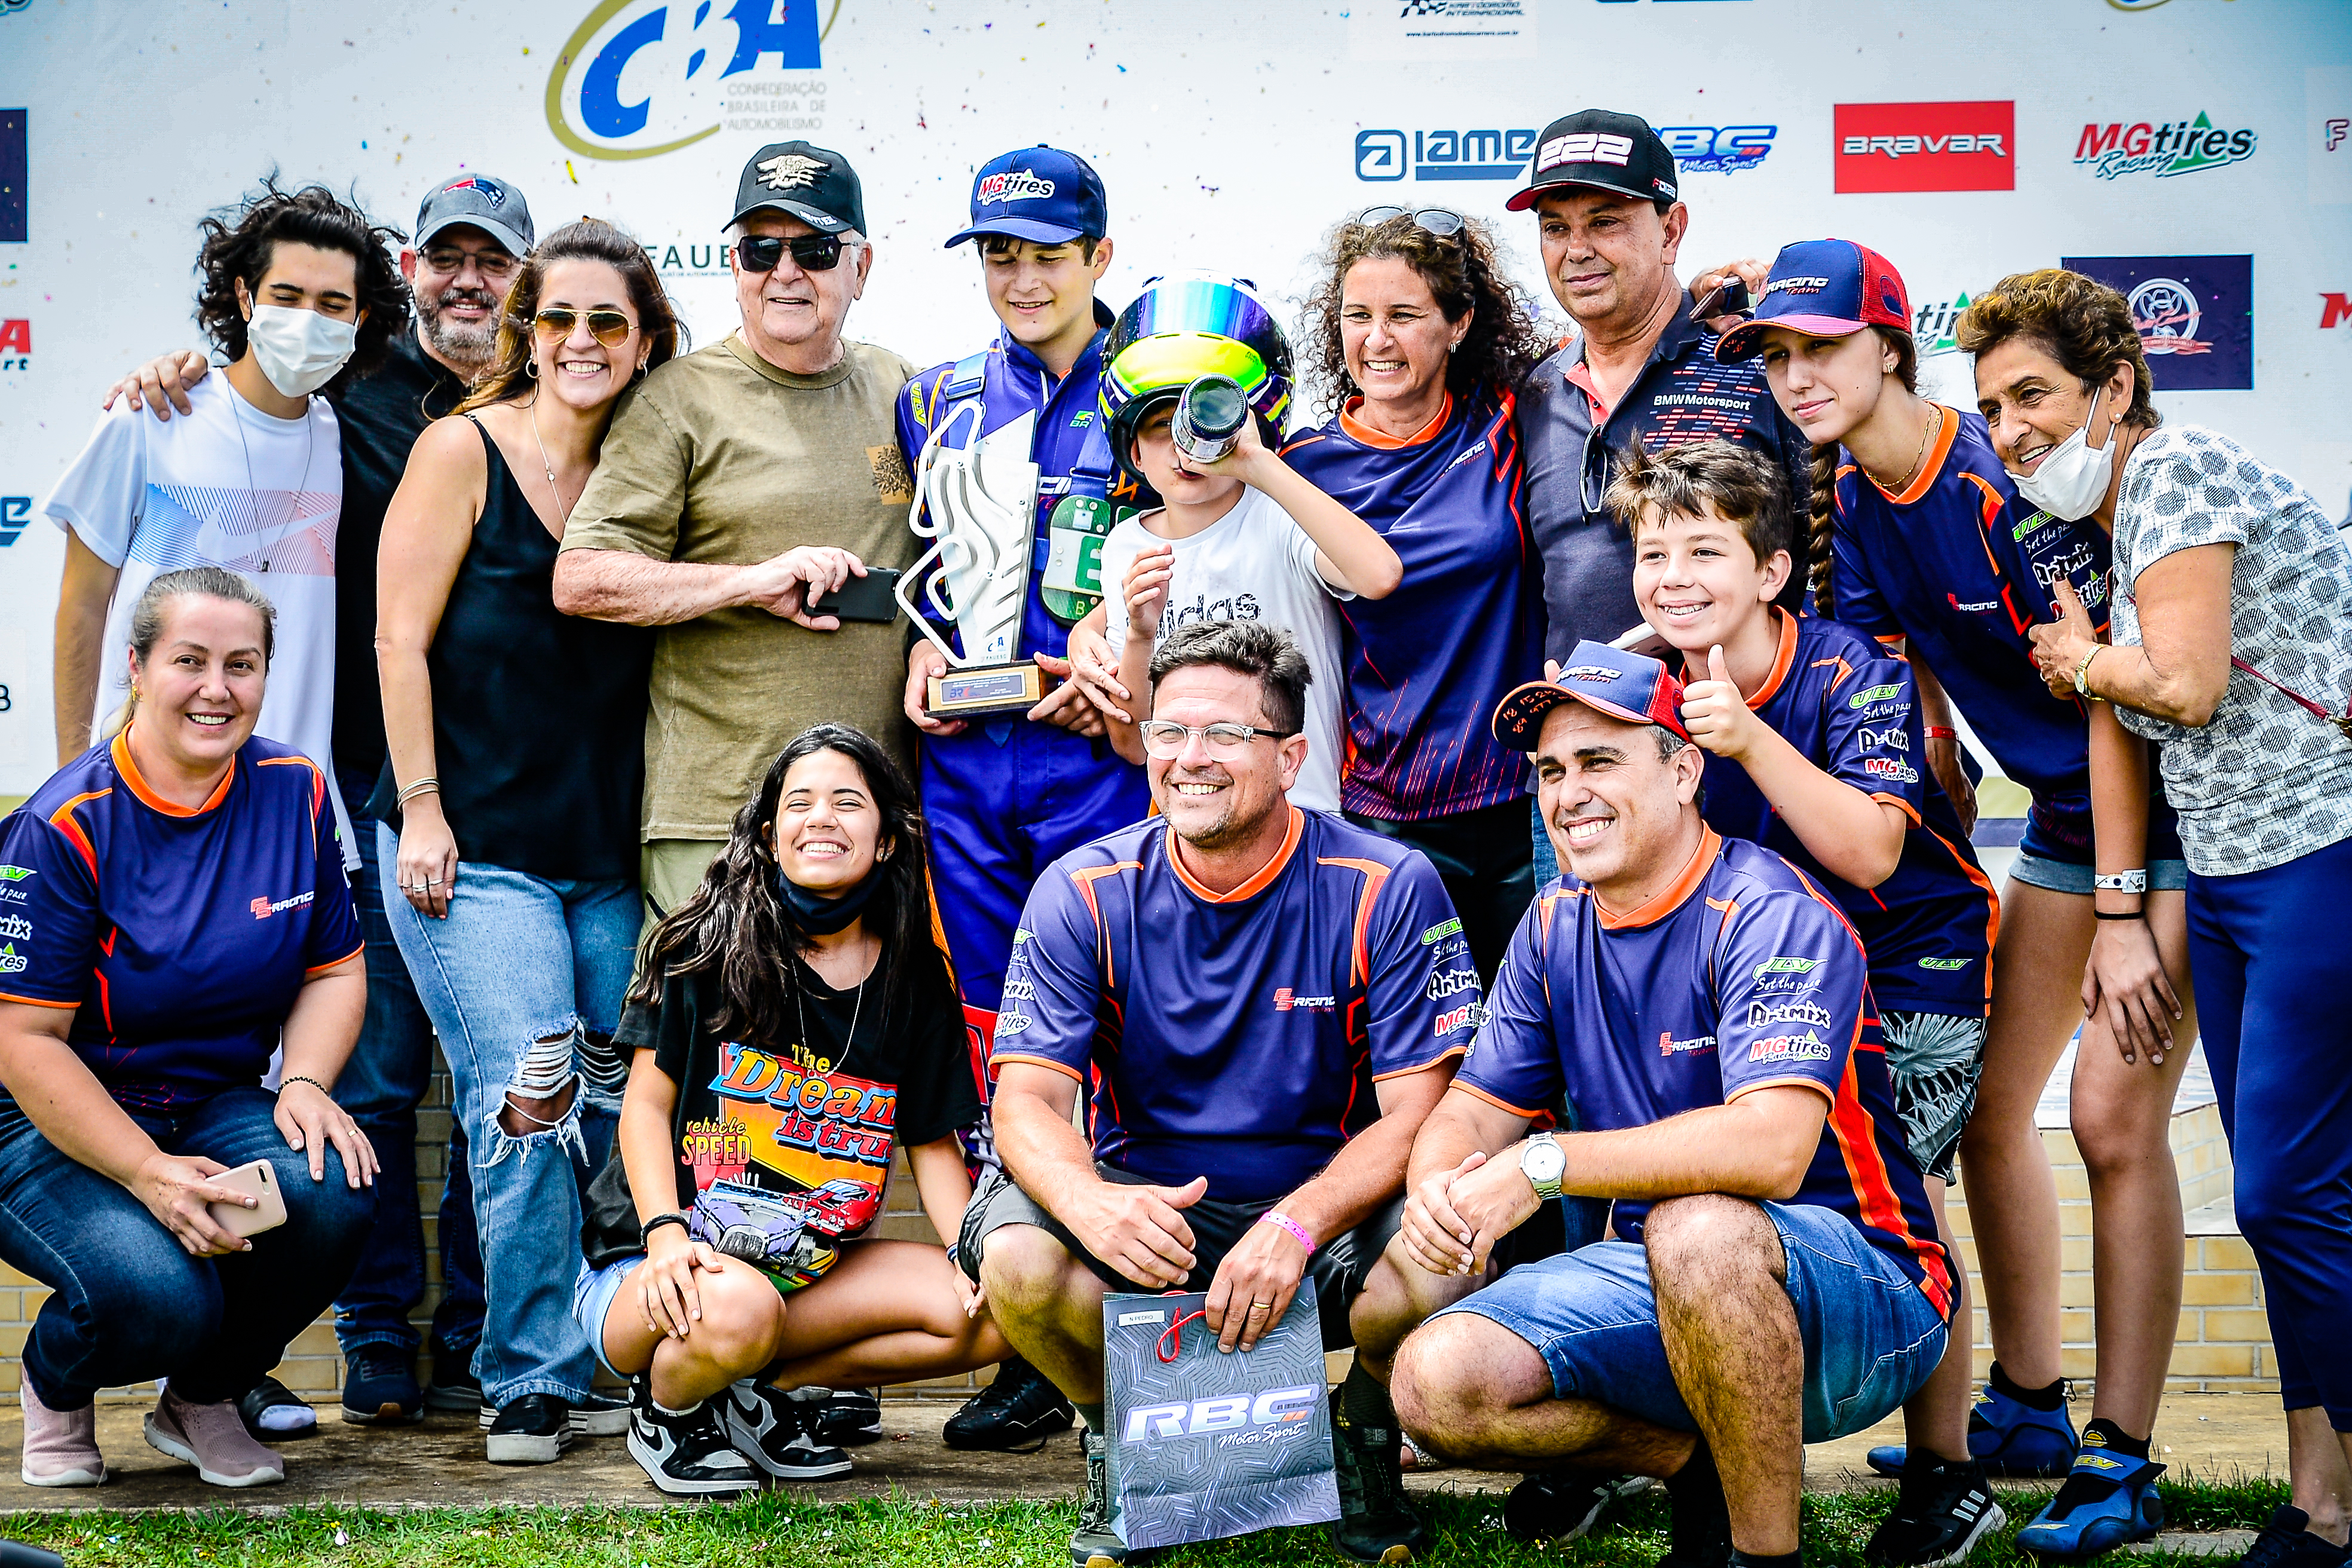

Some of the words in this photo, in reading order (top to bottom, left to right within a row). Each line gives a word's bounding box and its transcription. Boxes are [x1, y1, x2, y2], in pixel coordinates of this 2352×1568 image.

[727, 80, 828, 97] CONFEDERAÇÃO
[727, 100, 799, 112] BRASILEIRA
[810, 99, 826, 112] DE
[727, 117, 823, 130] AUTOMOBILISMO
[1538, 133, 1634, 173] 222
[979, 176, 1052, 198] MGtires
[1766, 277, 1829, 294] RACING
[1685, 394, 1751, 411] Motorsport
[1070, 419, 1091, 428] BR
[2042, 528, 2057, 543] the
[1880, 703, 1894, 715] the
[1756, 976, 1778, 991] Set
[1778, 976, 1796, 990] the
[1795, 978, 1821, 994] pace
[1751, 1039, 1829, 1059] MGtires
[792, 1044, 830, 1073] The
[778, 1111, 817, 1140] is
[818, 1120, 892, 1159] tru
[681, 1135, 751, 1165] SPEED
[1125, 1386, 1315, 1443] RBC
[1218, 1430, 1261, 1448] Motor
[1262, 1422, 1309, 1444] Sport
